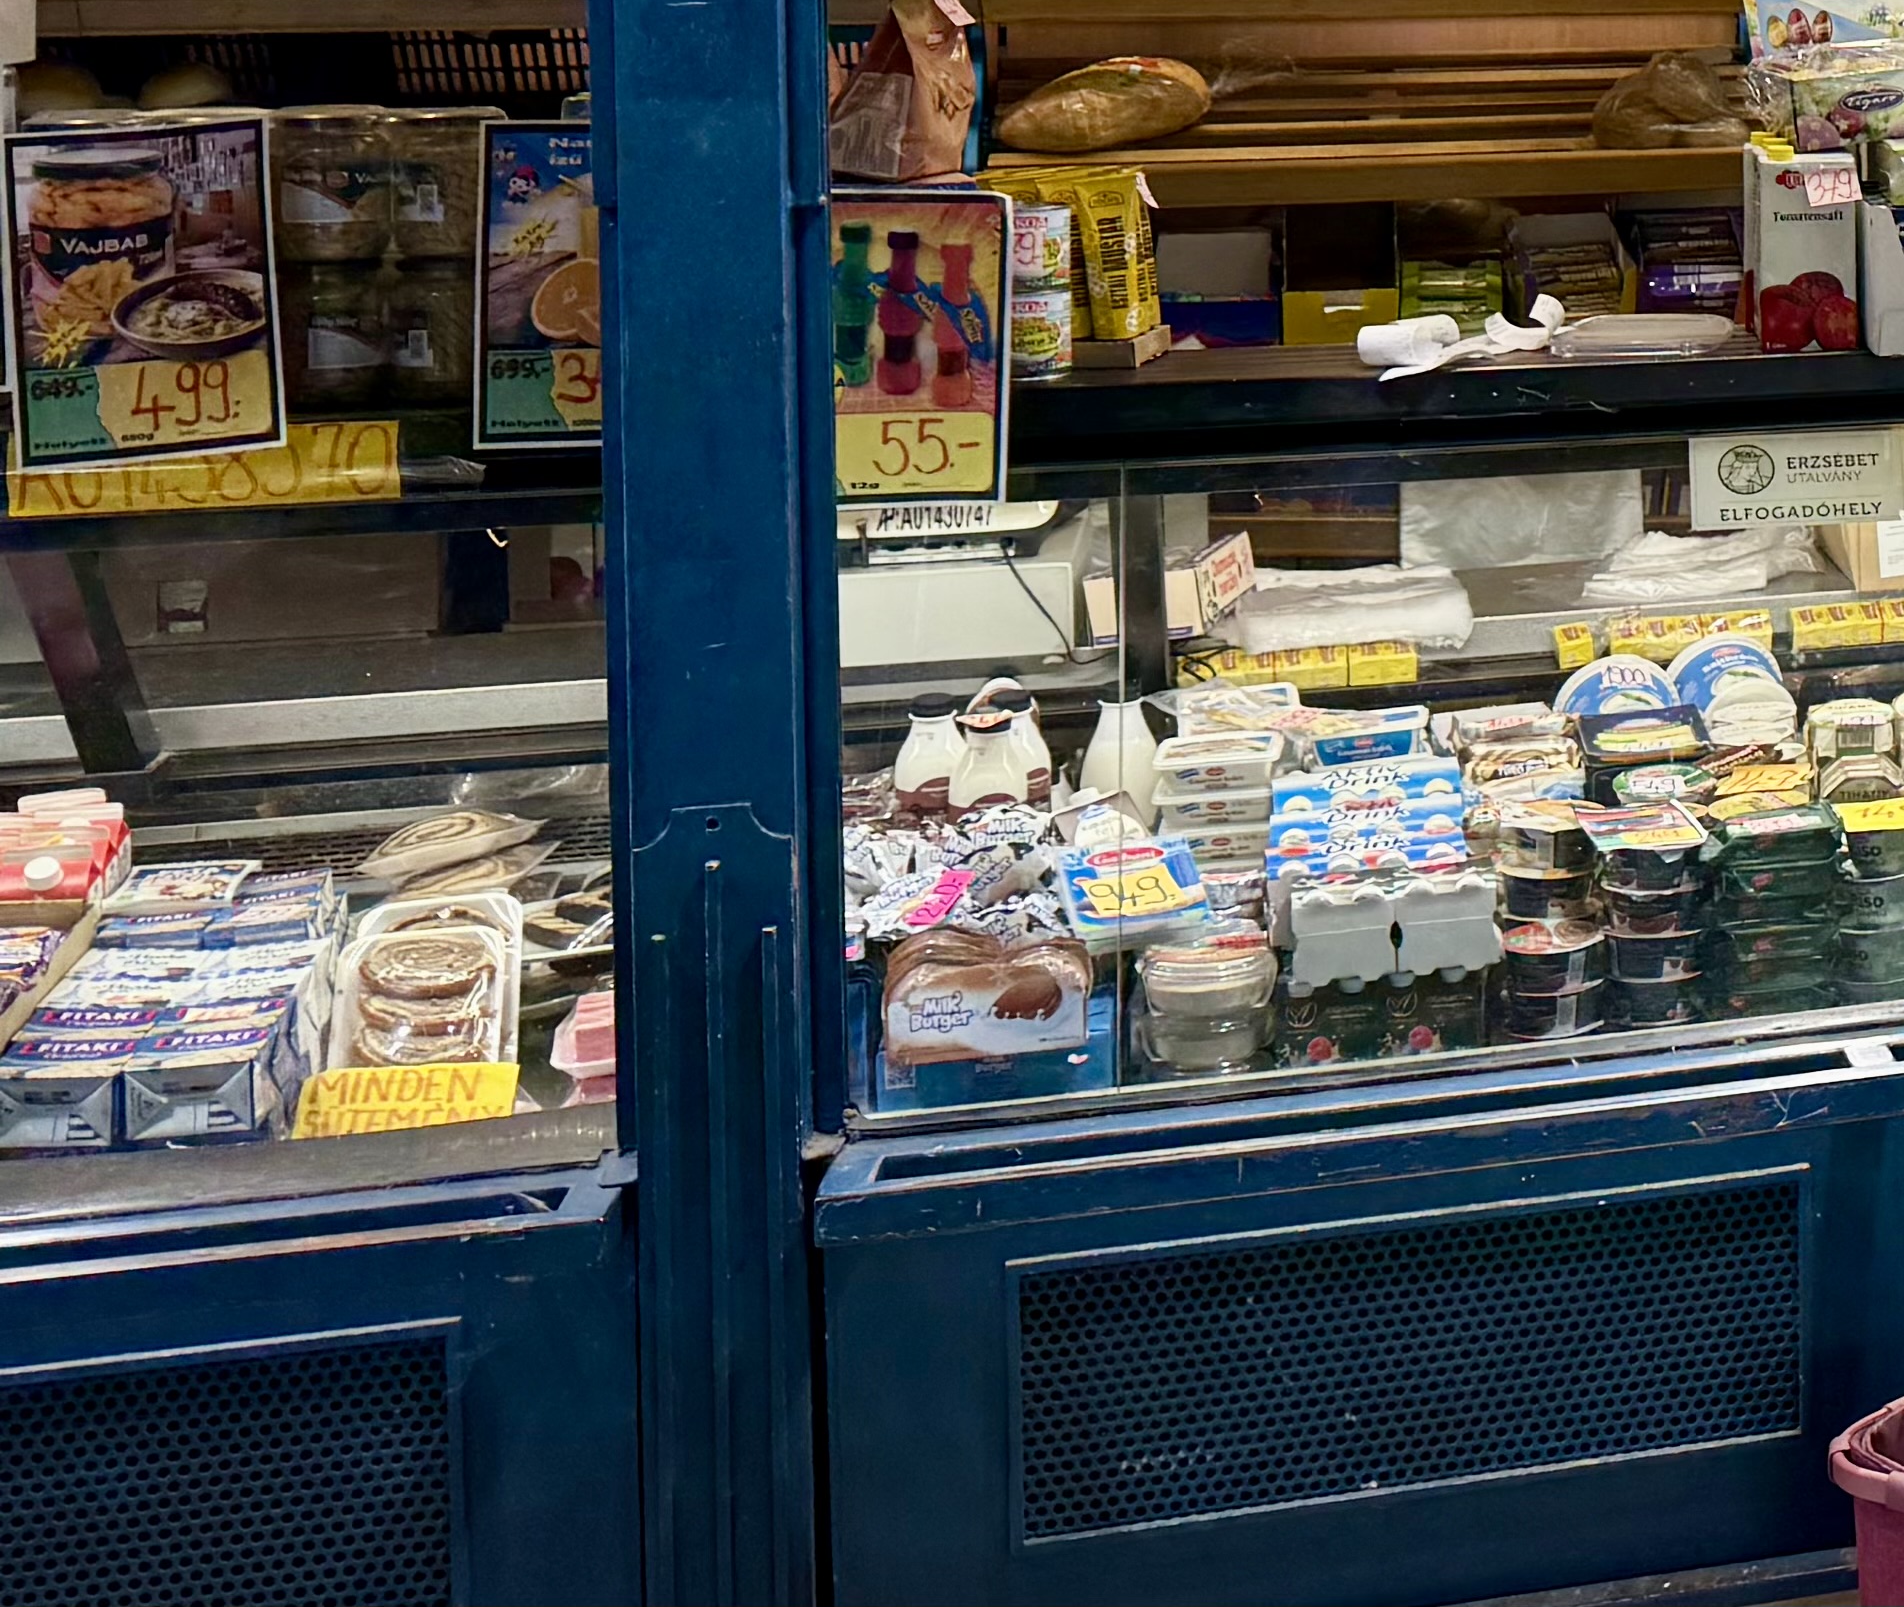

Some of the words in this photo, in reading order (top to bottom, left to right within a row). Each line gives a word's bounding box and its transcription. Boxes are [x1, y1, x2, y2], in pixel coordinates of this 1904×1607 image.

[60, 235, 149, 255] VAJBAB
[1786, 453, 1880, 470] ERZSÉBET
[1787, 470, 1862, 484] UTALVÁNY
[1720, 502, 1882, 522] ELFOGADÓHELY
[169, 1029, 257, 1044] FITAKI
[308, 1068, 484, 1106] MINDEN
